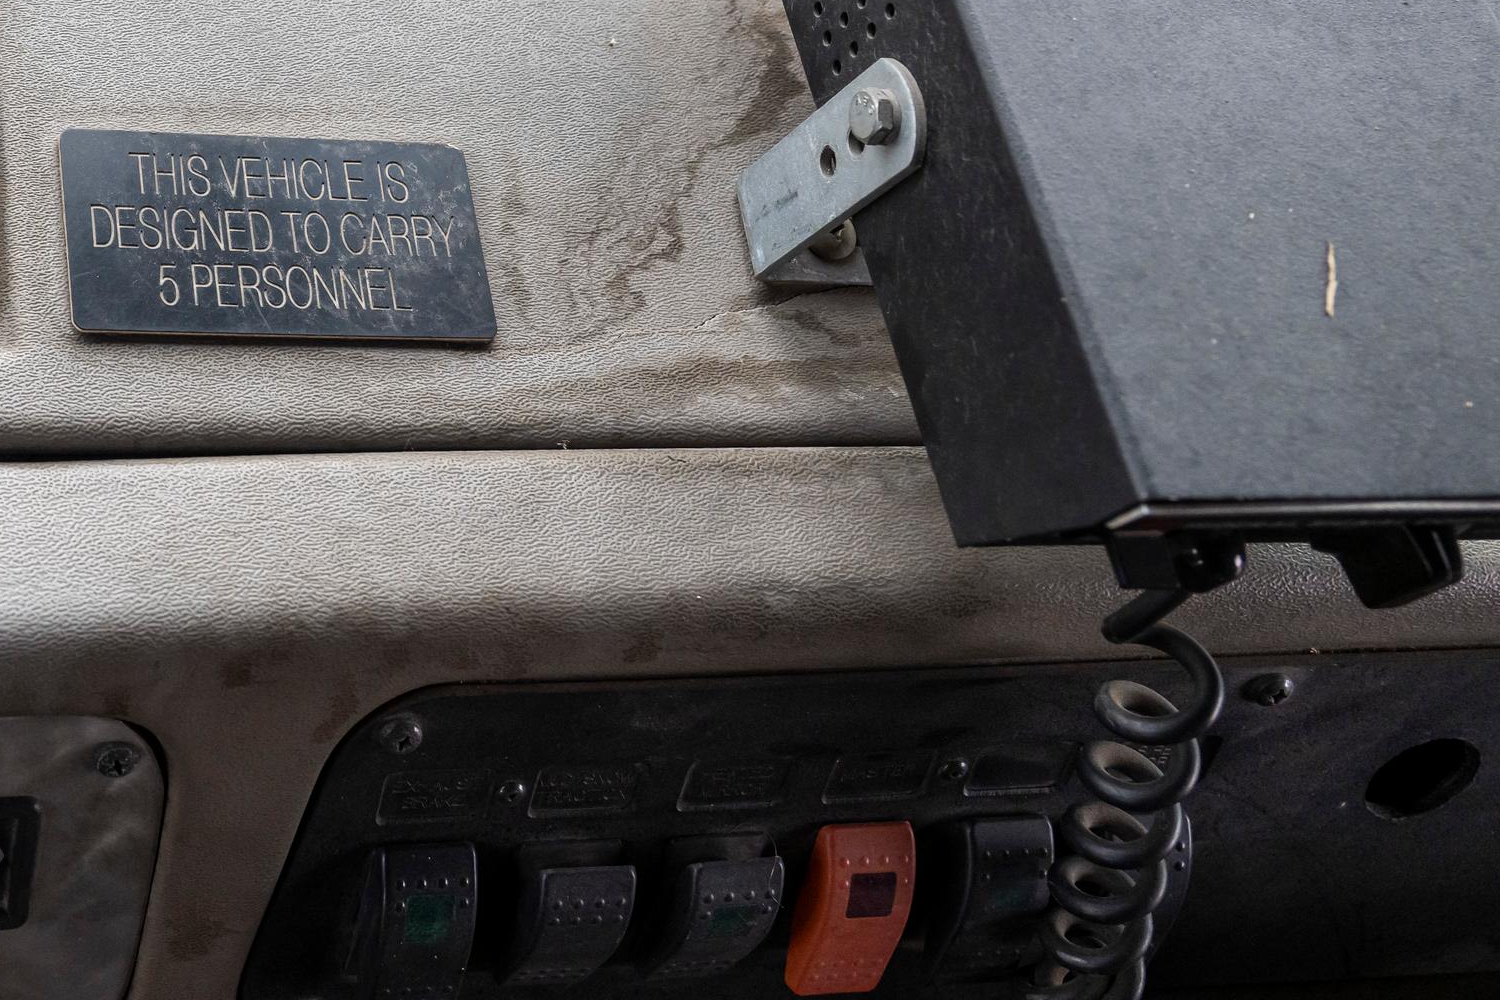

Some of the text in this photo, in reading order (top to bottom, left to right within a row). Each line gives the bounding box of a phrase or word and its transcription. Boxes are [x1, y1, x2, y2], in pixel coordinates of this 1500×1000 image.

[129, 152, 409, 202] THIS VEHICLE IS
[90, 203, 455, 258] DESIGNED TO CARRY
[158, 263, 414, 311] 5 PERSONNEL
